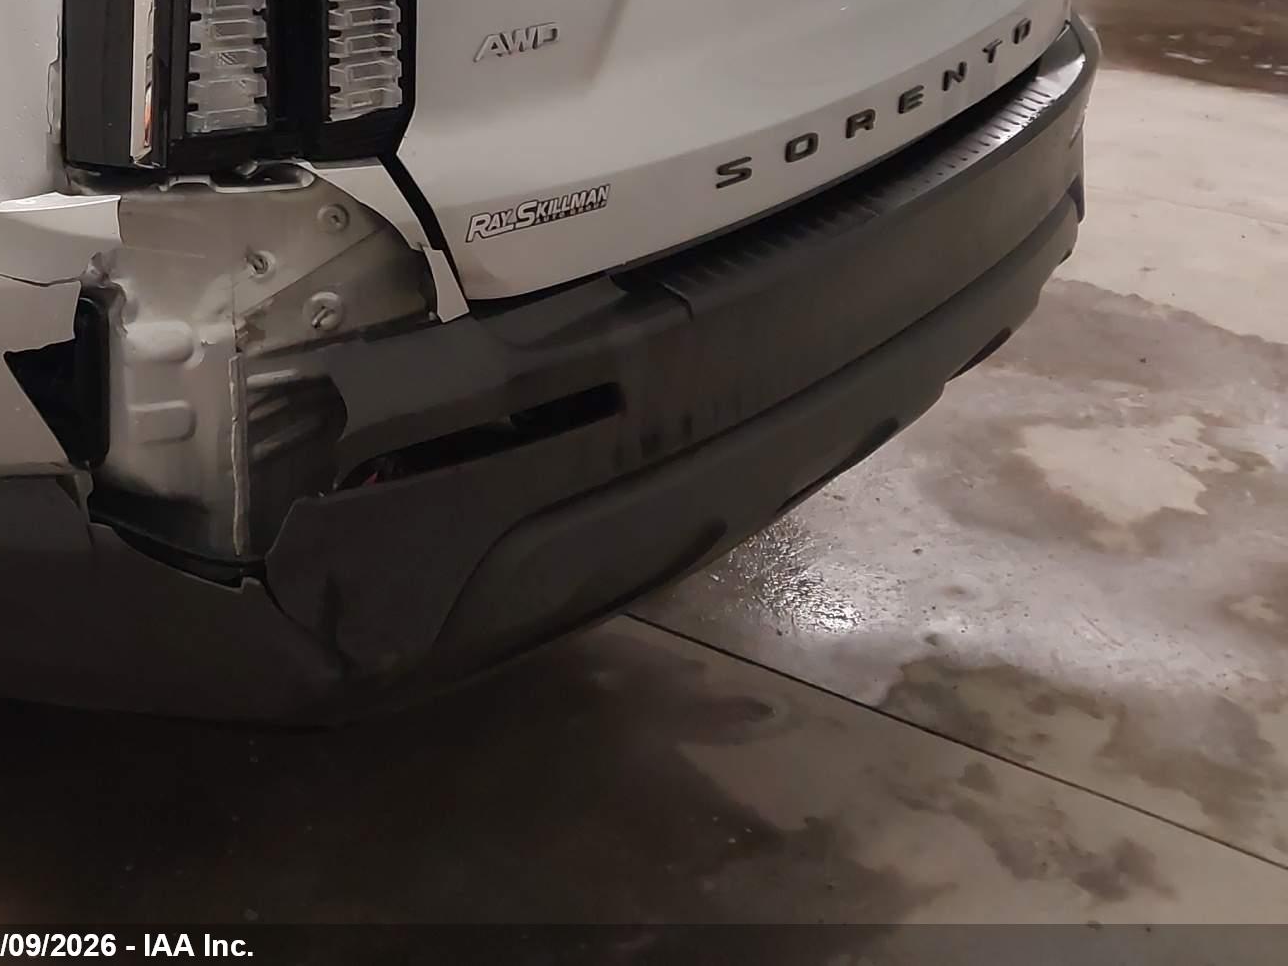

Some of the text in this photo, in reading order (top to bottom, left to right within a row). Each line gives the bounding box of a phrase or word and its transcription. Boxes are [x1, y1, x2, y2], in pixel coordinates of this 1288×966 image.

[473, 21, 559, 62] AWD
[715, 17, 1032, 189] SORENTO
[465, 184, 610, 242] RAY SKILLMAN
